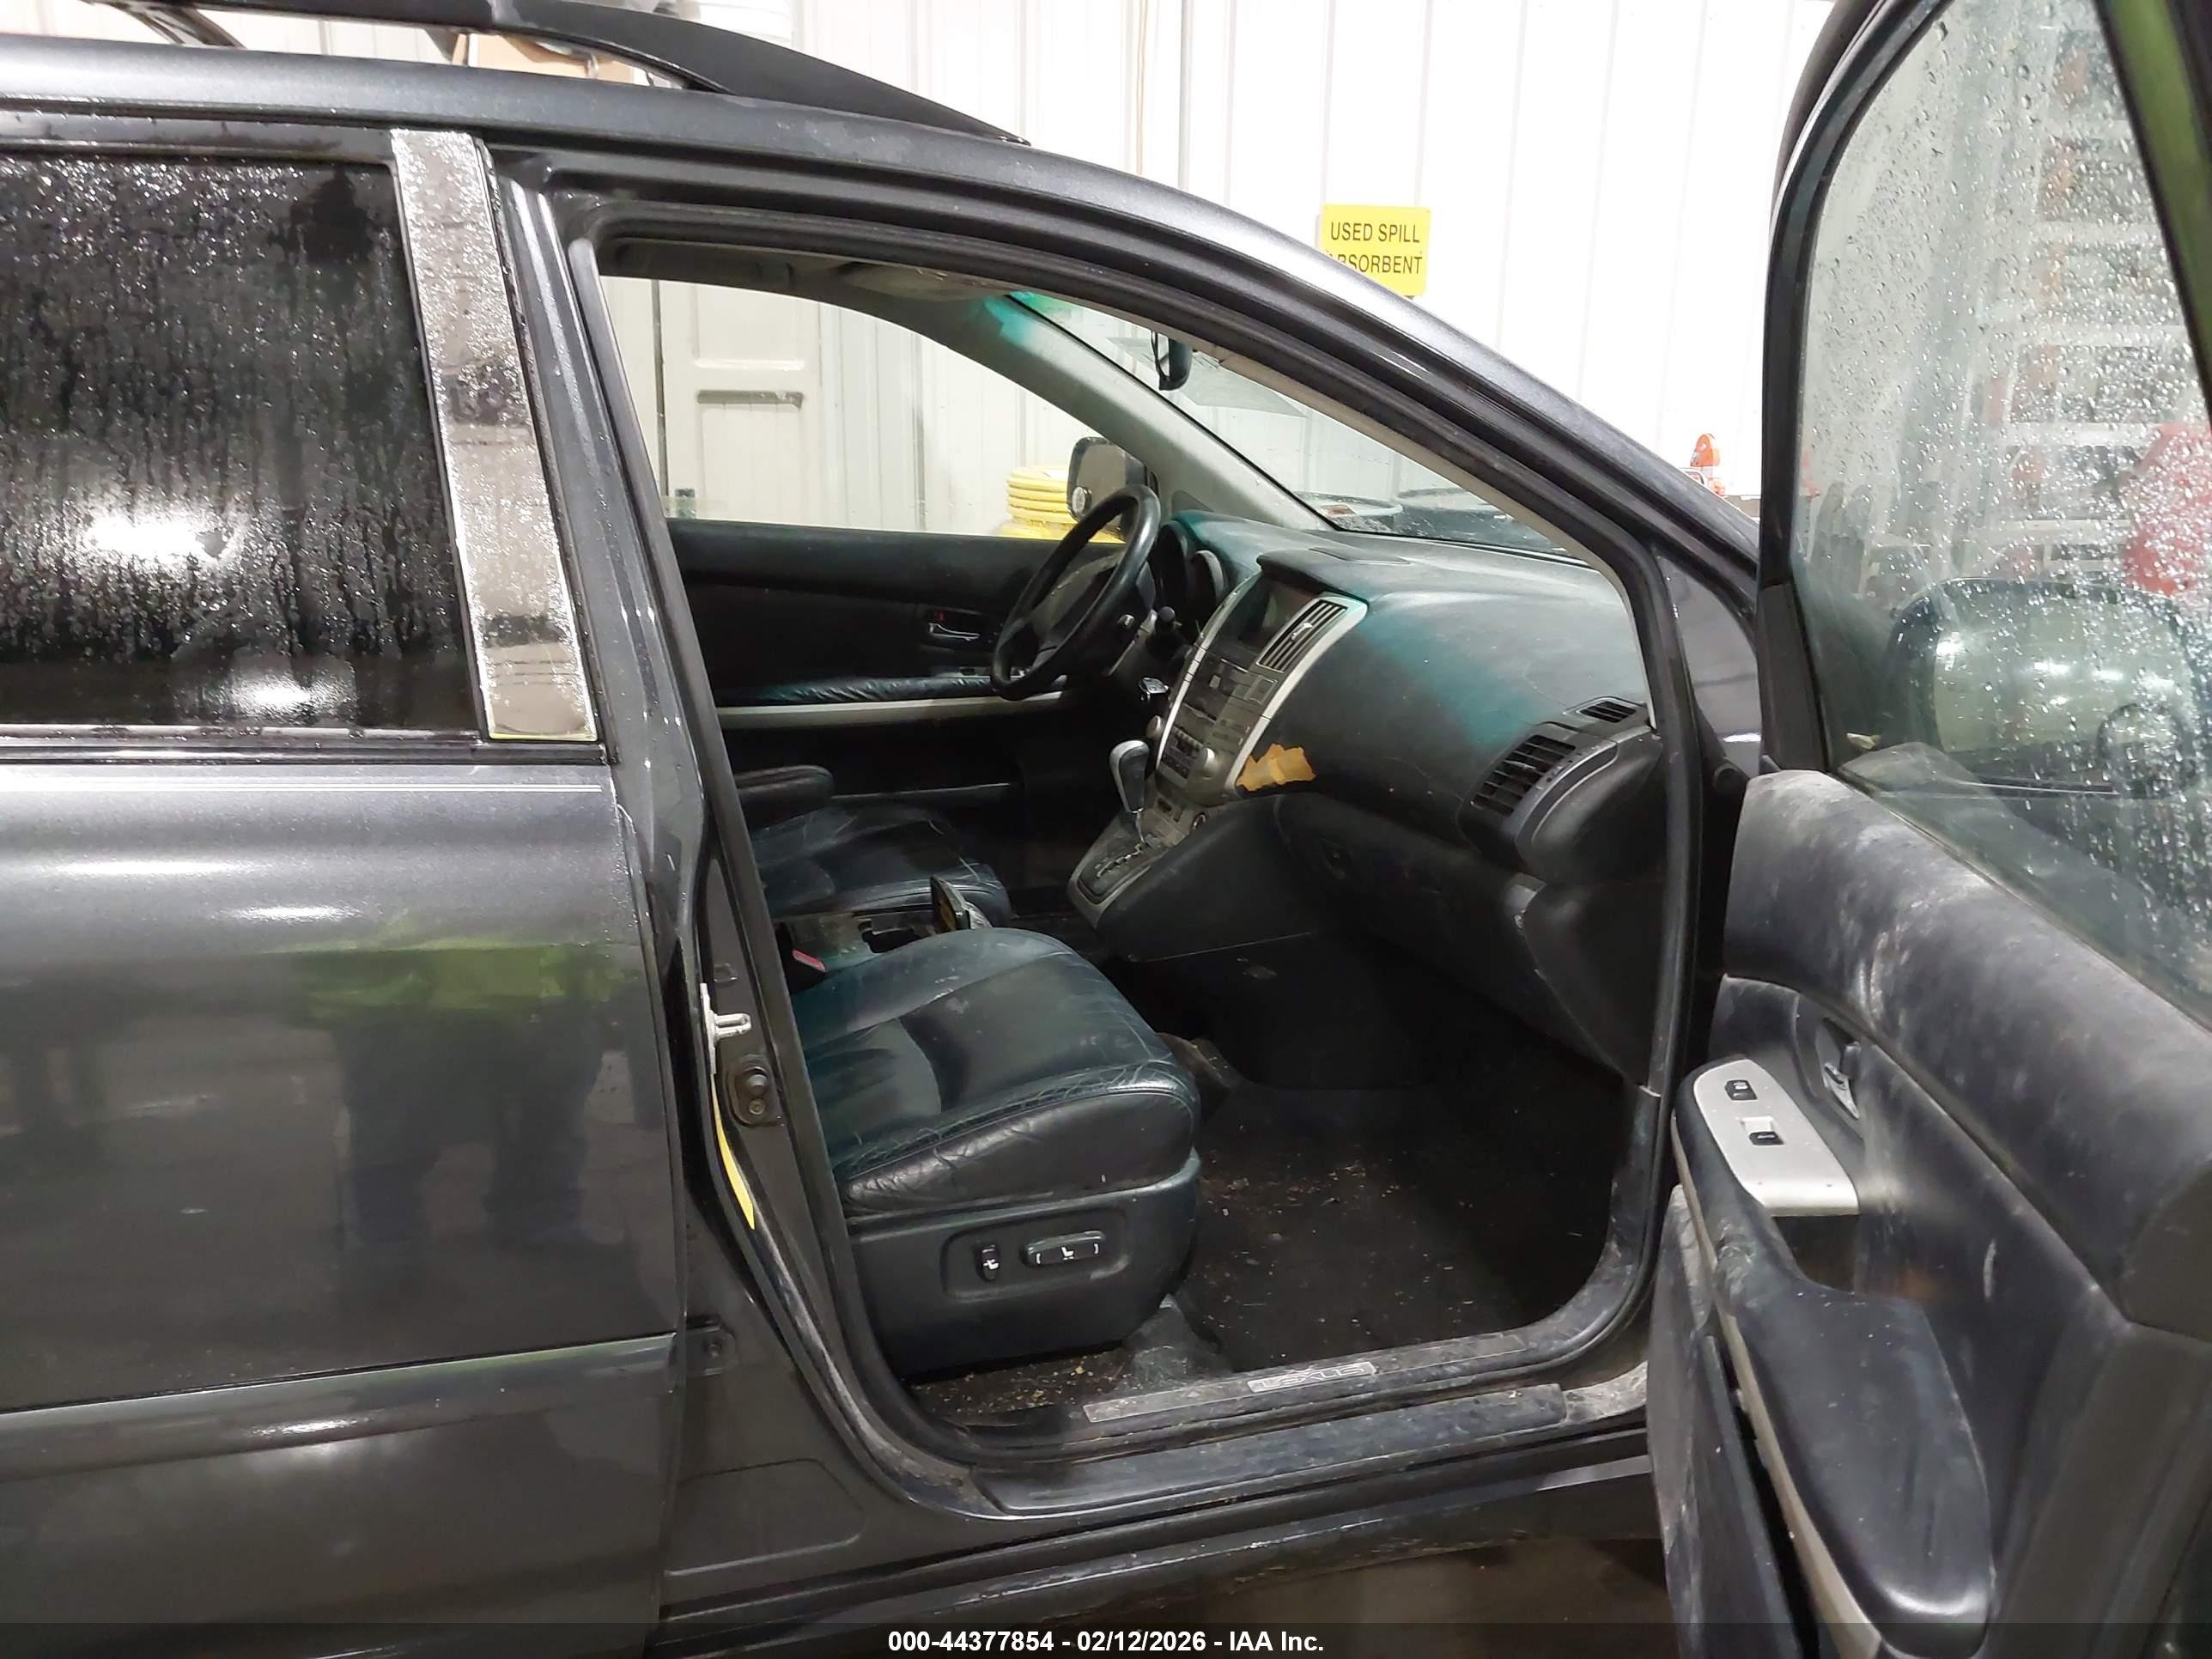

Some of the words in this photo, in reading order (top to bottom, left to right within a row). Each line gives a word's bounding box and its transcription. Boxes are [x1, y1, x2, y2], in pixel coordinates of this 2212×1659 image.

[1330, 222, 1373, 241] USED
[1378, 223, 1420, 243] SPILL
[1328, 253, 1423, 274] SORBENT
